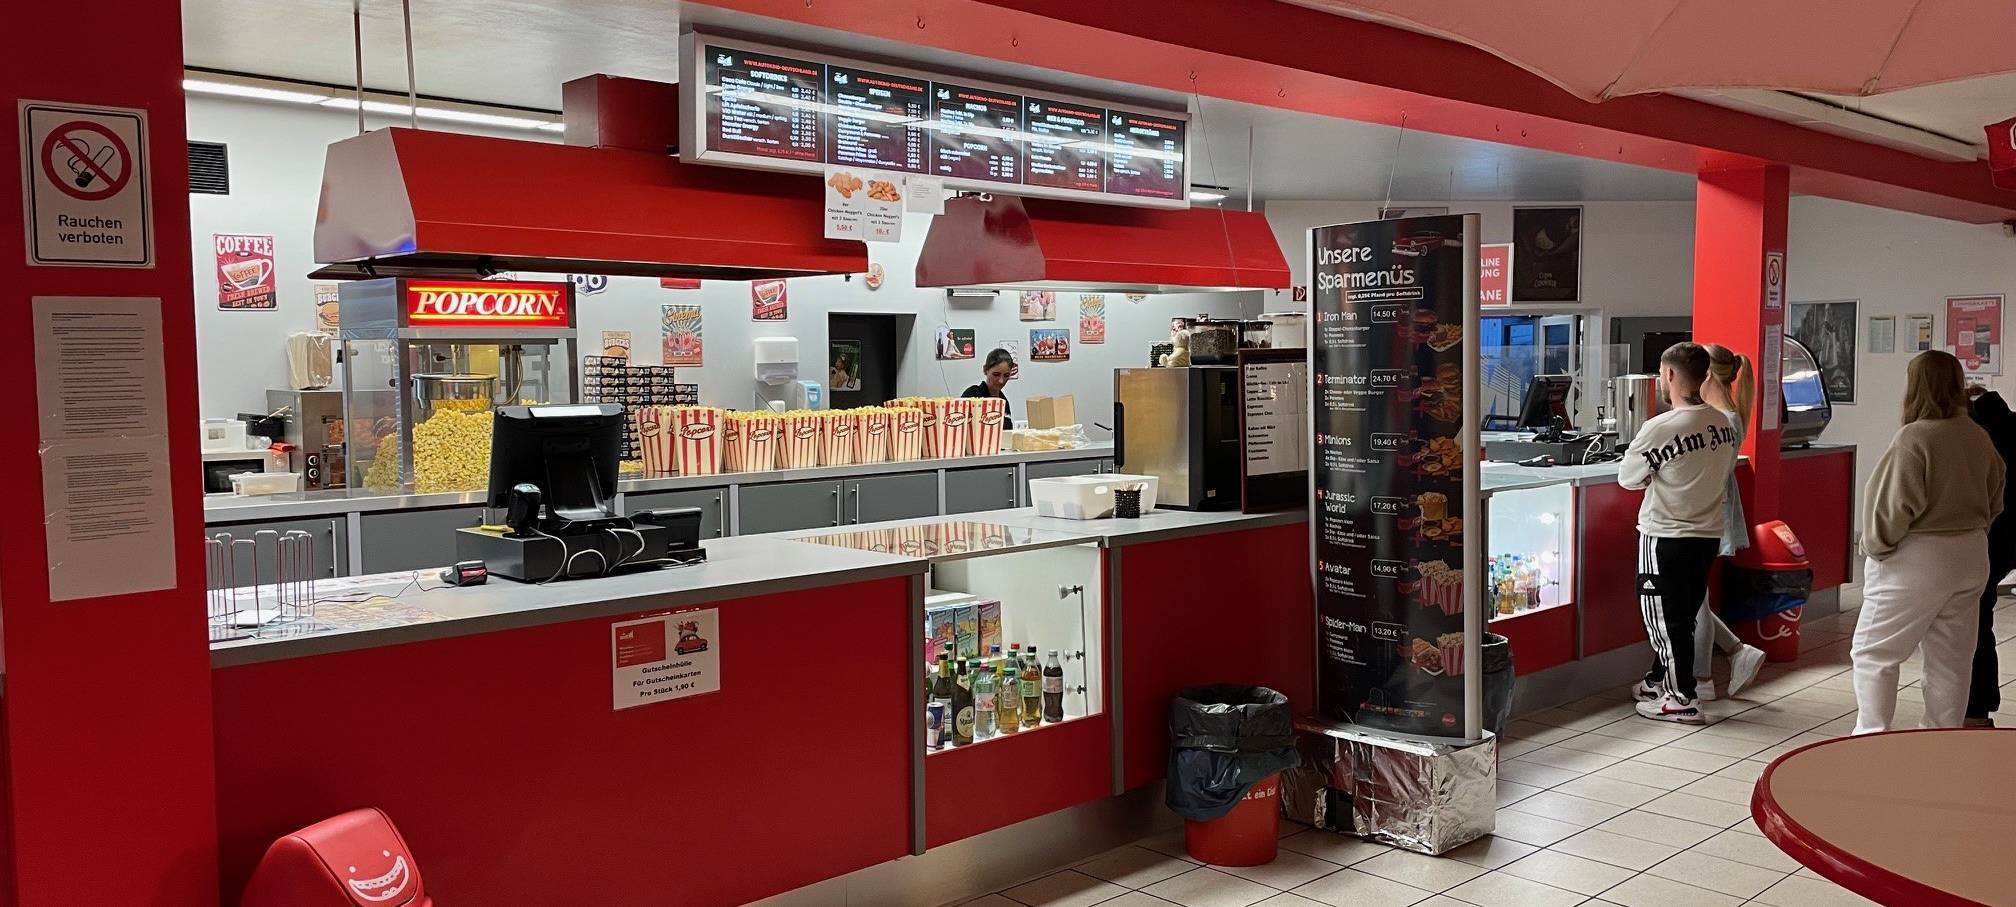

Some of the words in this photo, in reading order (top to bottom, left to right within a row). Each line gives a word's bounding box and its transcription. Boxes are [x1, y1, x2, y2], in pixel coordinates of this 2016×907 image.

[750, 70, 788, 82] SOFTDRINKS
[963, 142, 988, 152] POPCORN
[58, 214, 123, 229] Rauchen
[58, 231, 123, 245] verboten
[216, 235, 273, 257] COFFEE
[1318, 246, 1373, 265] Unsere
[1317, 264, 1415, 295] Sparmenüs
[227, 289, 247, 301] FRESH
[247, 284, 271, 297] BREWED
[1371, 291, 1386, 299] Pfand
[1396, 290, 1421, 298] Softdrink
[413, 290, 560, 317] POPCORN
[1317, 312, 1322, 321] 1
[1324, 311, 1340, 321] Iron
[1341, 310, 1358, 321] Man
[1391, 310, 1397, 318] €
[1317, 374, 1322, 384] 2
[1324, 373, 1367, 385] Terminator
[1392, 374, 1397, 382] €
[1367, 390, 1384, 398] Burger
[945, 412, 966, 425] Popcorn
[981, 411, 1002, 424] Popcorn
[681, 423, 716, 437] Popcorn
[1317, 434, 1323, 444] 3
[1324, 433, 1353, 446] Minions
[1392, 438, 1397, 446] €
[1641, 432, 1707, 472] Palm
[1317, 488, 1322, 500] 4
[1324, 489, 1356, 503] Jurassic
[1392, 503, 1397, 511] €
[1325, 502, 1347, 514] World
[1319, 560, 1323, 571] 5
[1324, 562, 1352, 576] Avatar
[1392, 565, 1397, 574] €
[1325, 615, 1367, 634] Spider-Man
[1374, 627, 1392, 636] 13,20
[1392, 628, 1397, 637] €
[642, 660, 692, 674] Gutscheinhülle
[645, 670, 702, 686] Gutscheinkarten
[640, 690, 652, 698] Pro
[653, 686, 673, 696] Stück
[675, 683, 689, 692] 1,90
[690, 682, 695, 690] €
[1254, 789, 1266, 799] ein
